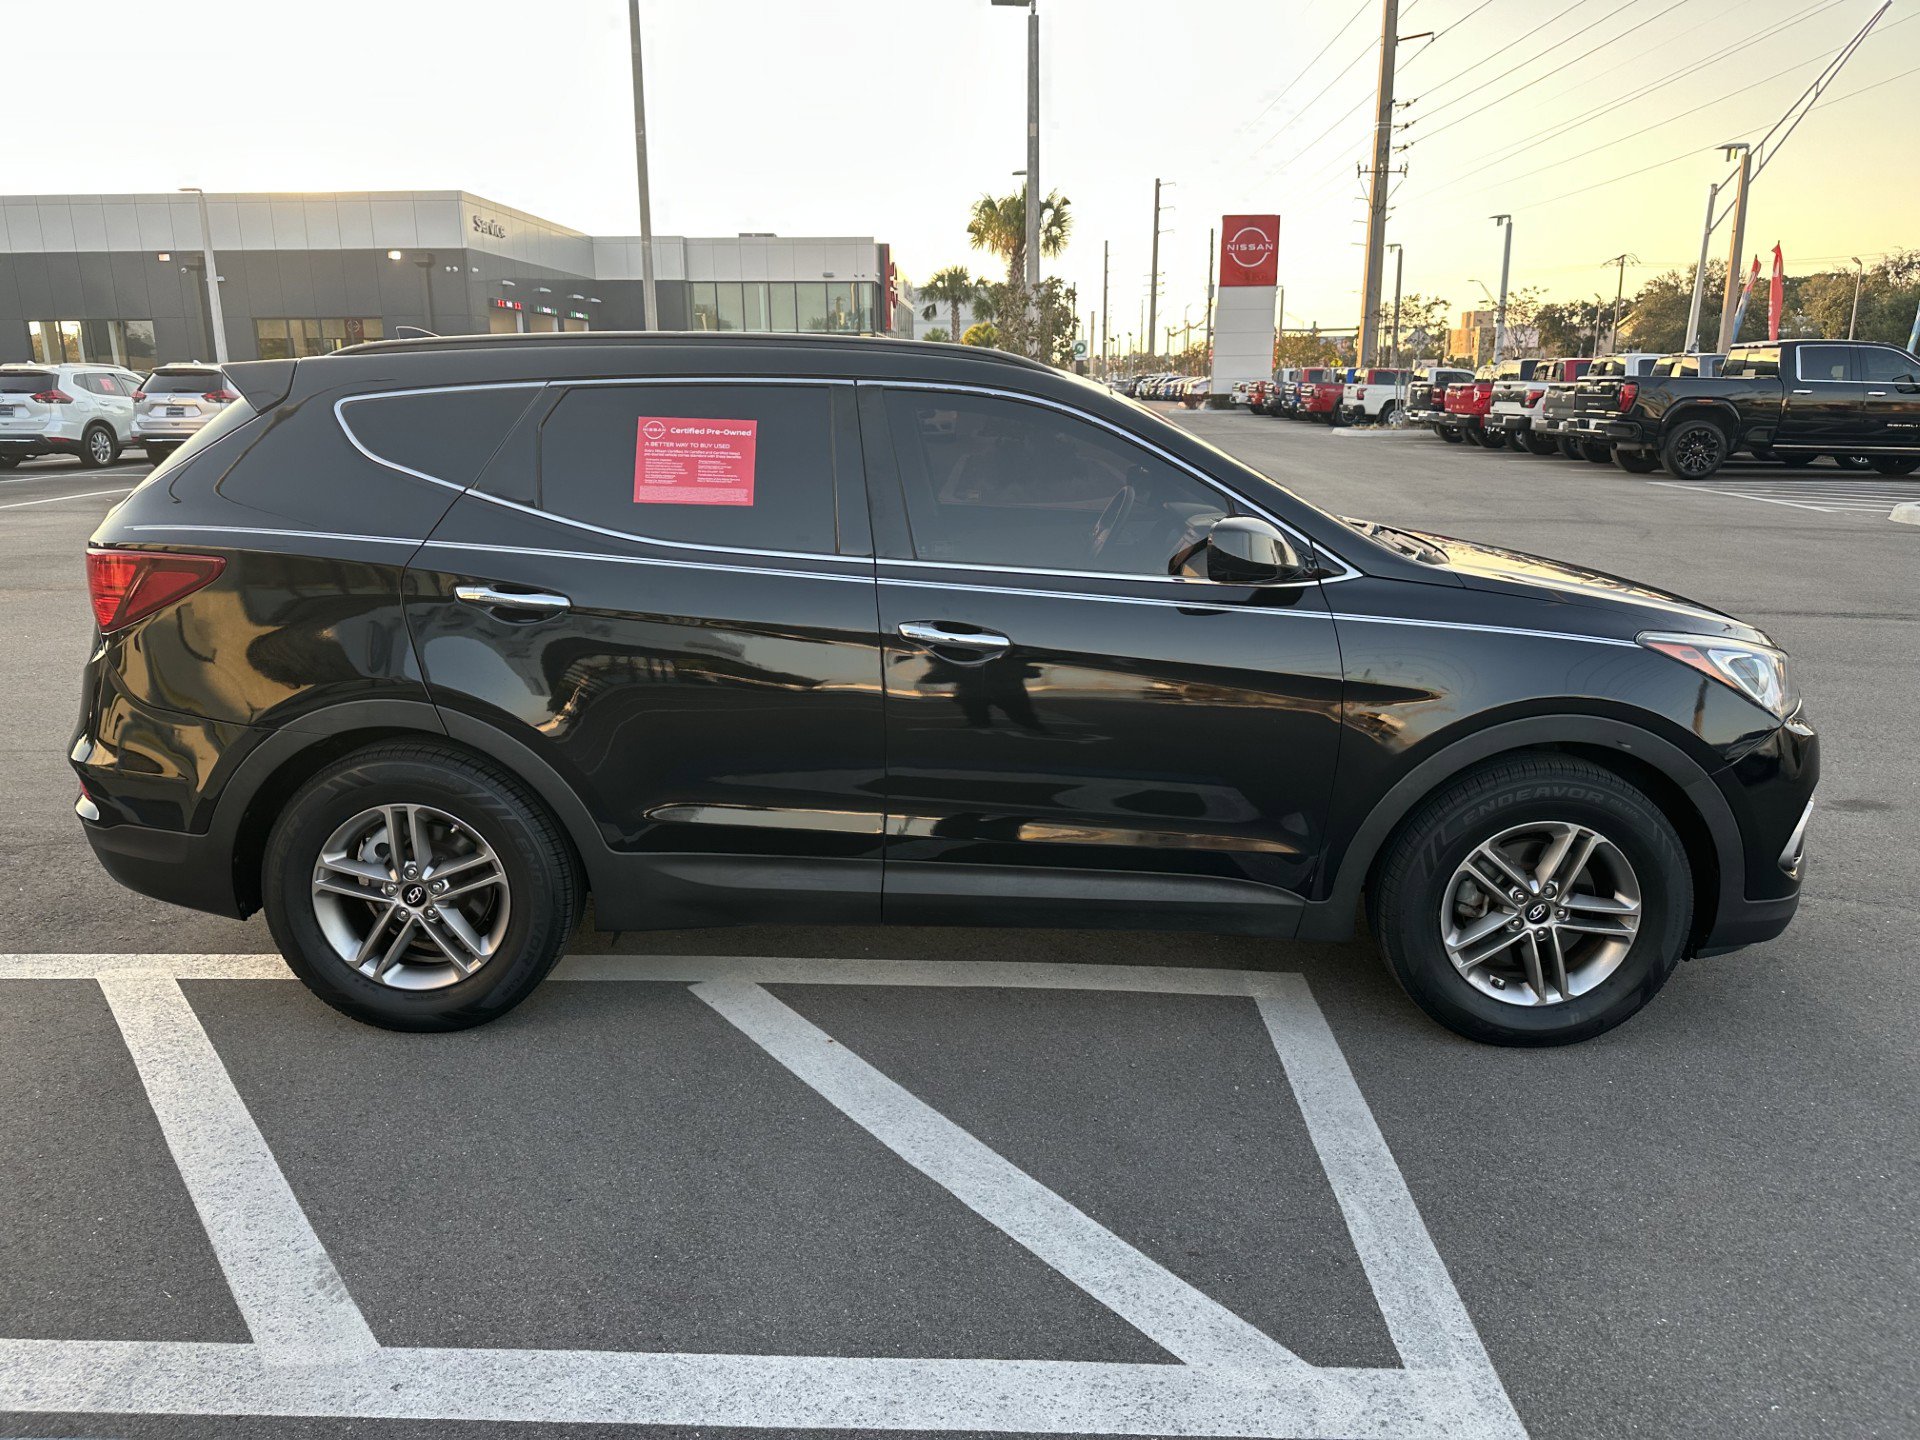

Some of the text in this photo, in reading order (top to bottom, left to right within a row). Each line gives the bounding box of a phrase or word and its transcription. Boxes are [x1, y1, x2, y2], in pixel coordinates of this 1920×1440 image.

[473, 215, 506, 239] Service
[1226, 243, 1274, 251] NISSAN
[670, 427, 752, 436] Certified Pre-Owned
[1463, 786, 1605, 825] ENDEAVOR
